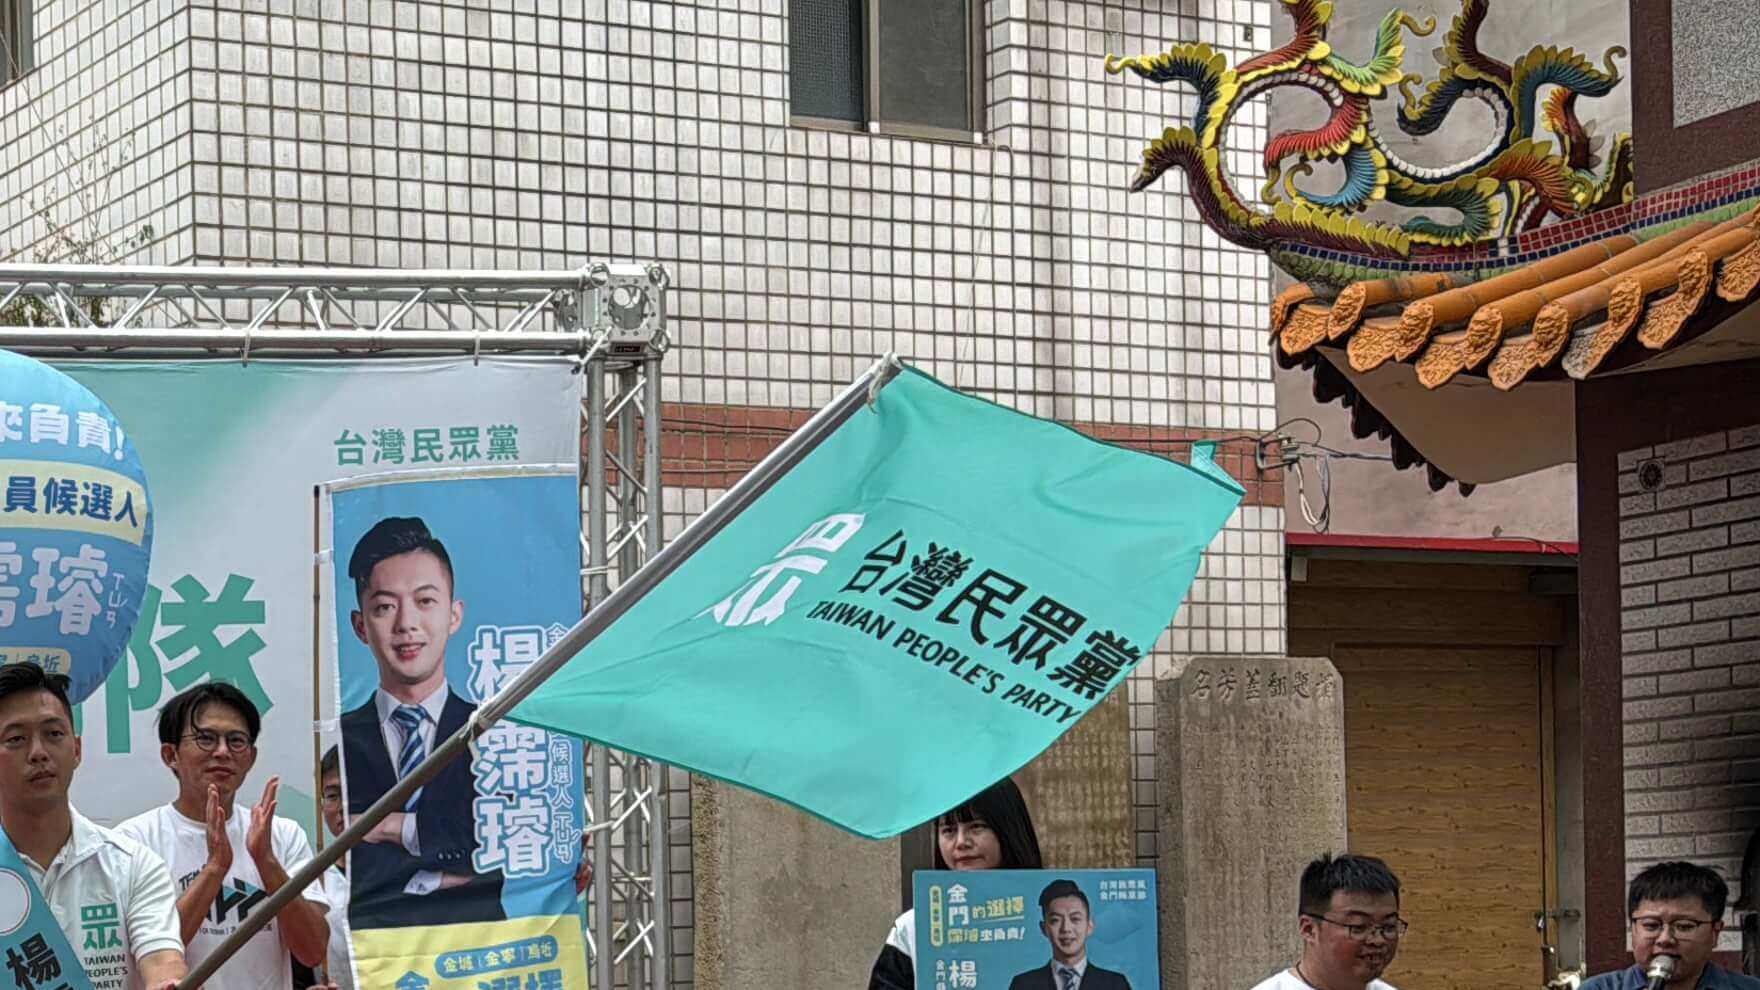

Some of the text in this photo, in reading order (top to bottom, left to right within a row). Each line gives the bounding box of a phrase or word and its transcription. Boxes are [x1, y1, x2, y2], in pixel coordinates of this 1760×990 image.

[334, 424, 520, 465] 台灣民眾黨
[840, 529, 1140, 700] 台灣民眾黨
[807, 601, 1082, 724] TAIWAN PEOPLE'S PARTY
[947, 884, 969, 926] 金門
